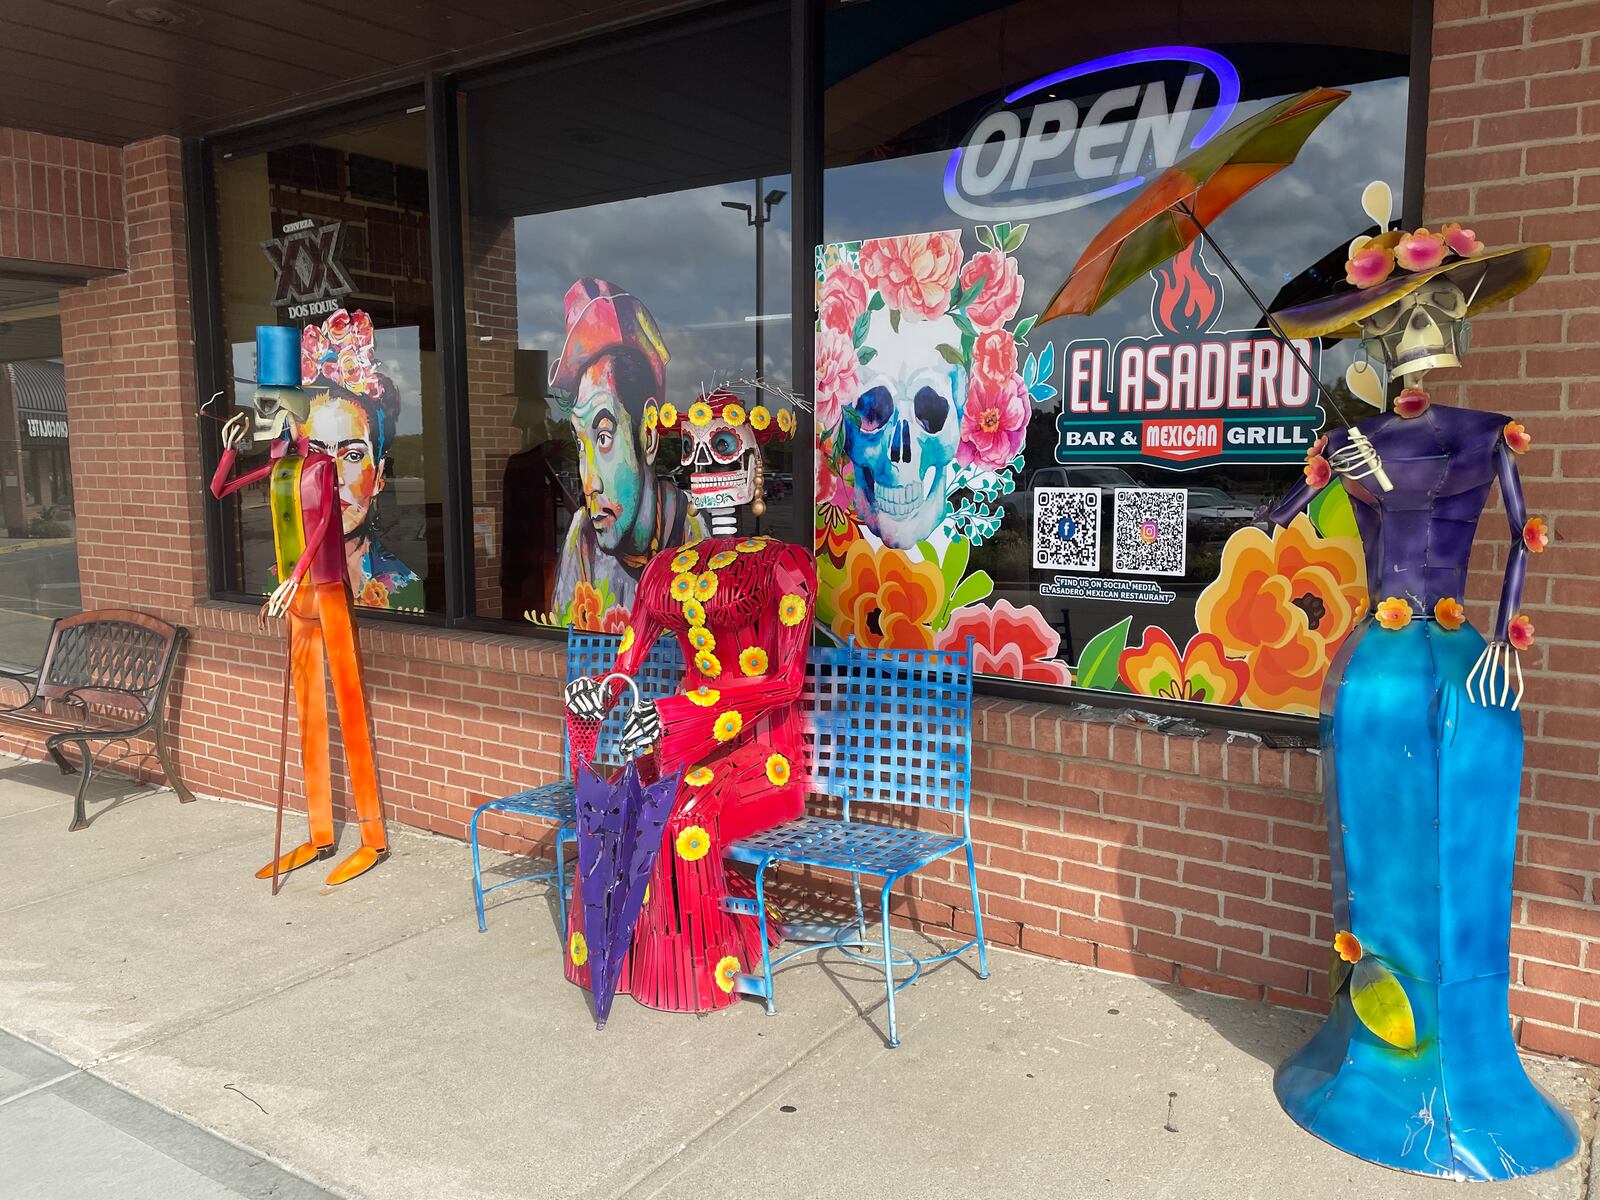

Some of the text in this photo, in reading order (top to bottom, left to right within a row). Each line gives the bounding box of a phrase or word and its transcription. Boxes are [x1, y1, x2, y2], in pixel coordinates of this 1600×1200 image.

[961, 72, 1204, 196] OPEN
[282, 219, 315, 233] CERVEZA
[261, 222, 352, 306] XX
[288, 299, 339, 319] DOS EQUIS
[1070, 339, 1312, 413] EL ASADERO
[1066, 425, 1308, 447] BAR & MEXICAN GRILL
[1041, 586, 1051, 594] EL
[1052, 586, 1085, 596] ASADERO
[1086, 588, 1119, 598] MEXICAN
[1079, 579, 1090, 588] US
[1091, 580, 1102, 588] ON
[1103, 581, 1131, 590] SOCIAL
